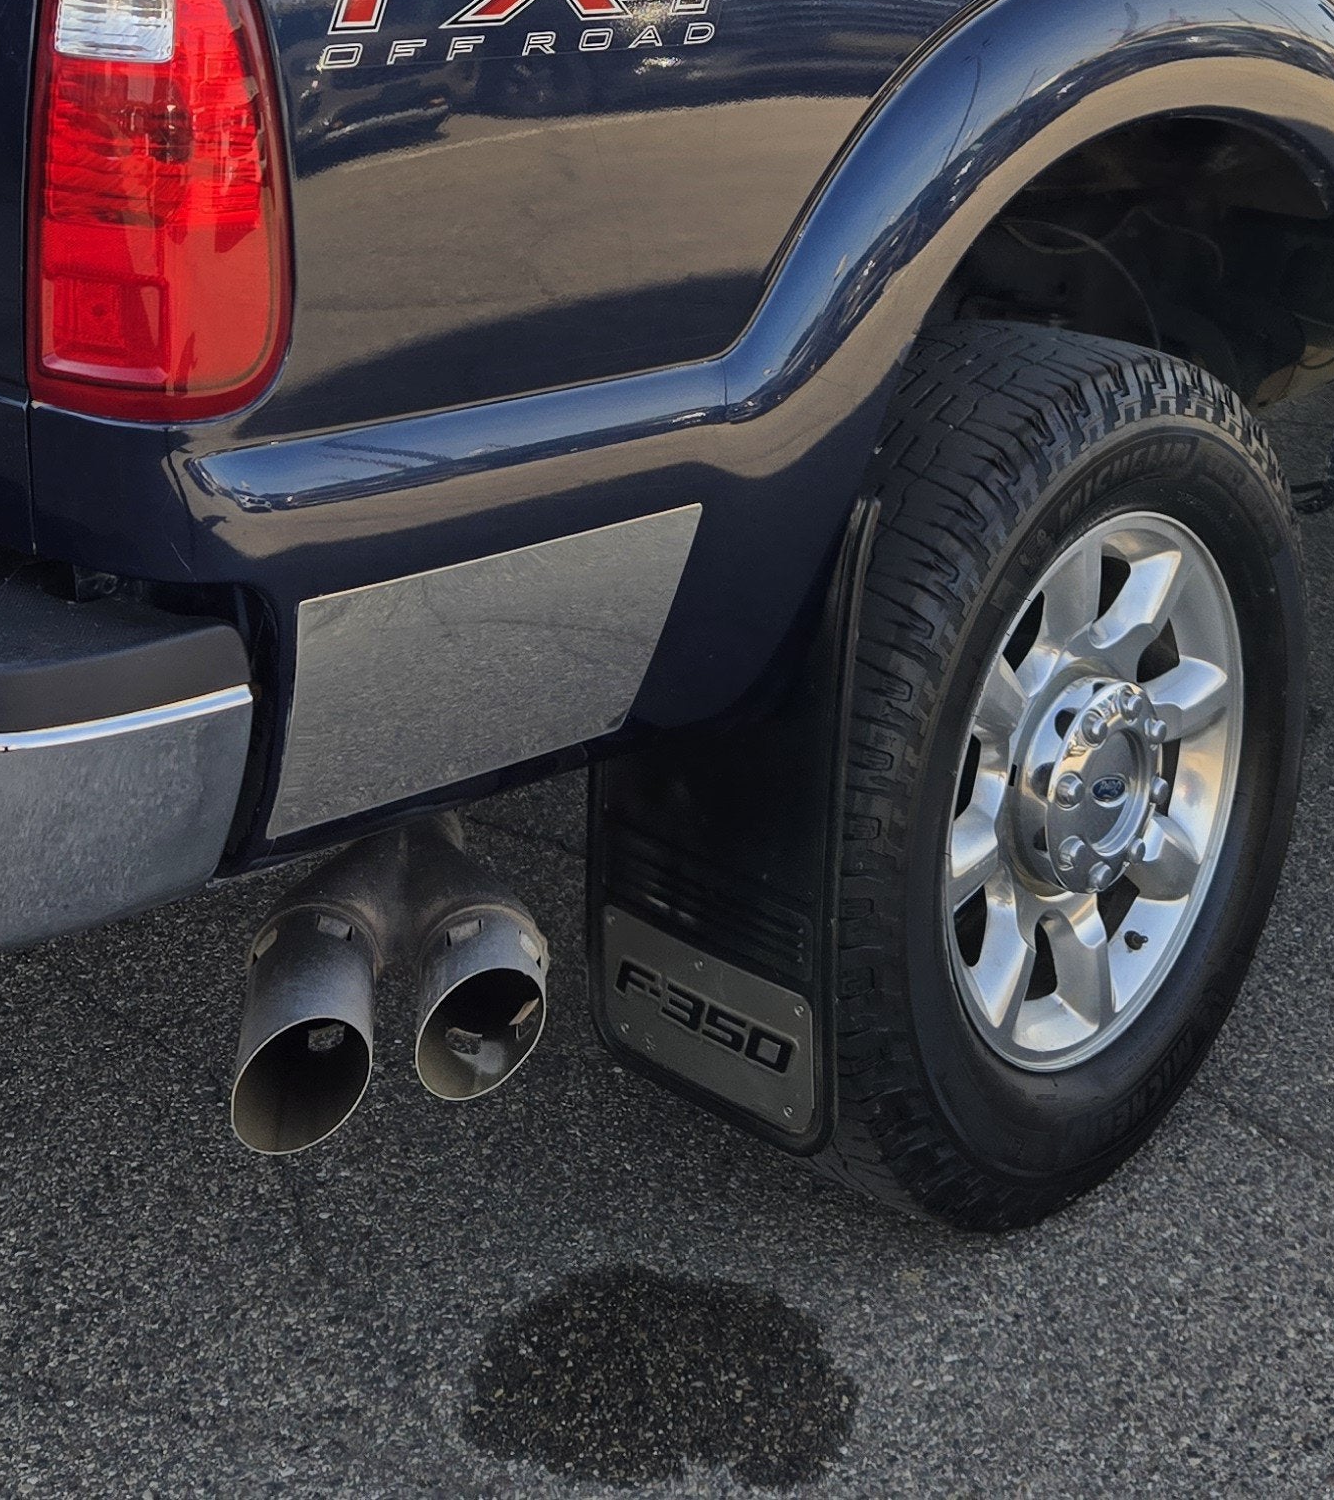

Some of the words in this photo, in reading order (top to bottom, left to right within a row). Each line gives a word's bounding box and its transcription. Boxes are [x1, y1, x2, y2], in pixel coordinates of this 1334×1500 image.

[320, 35, 486, 70] OFF
[521, 22, 717, 57] ROAD
[615, 956, 796, 1075] F-350
